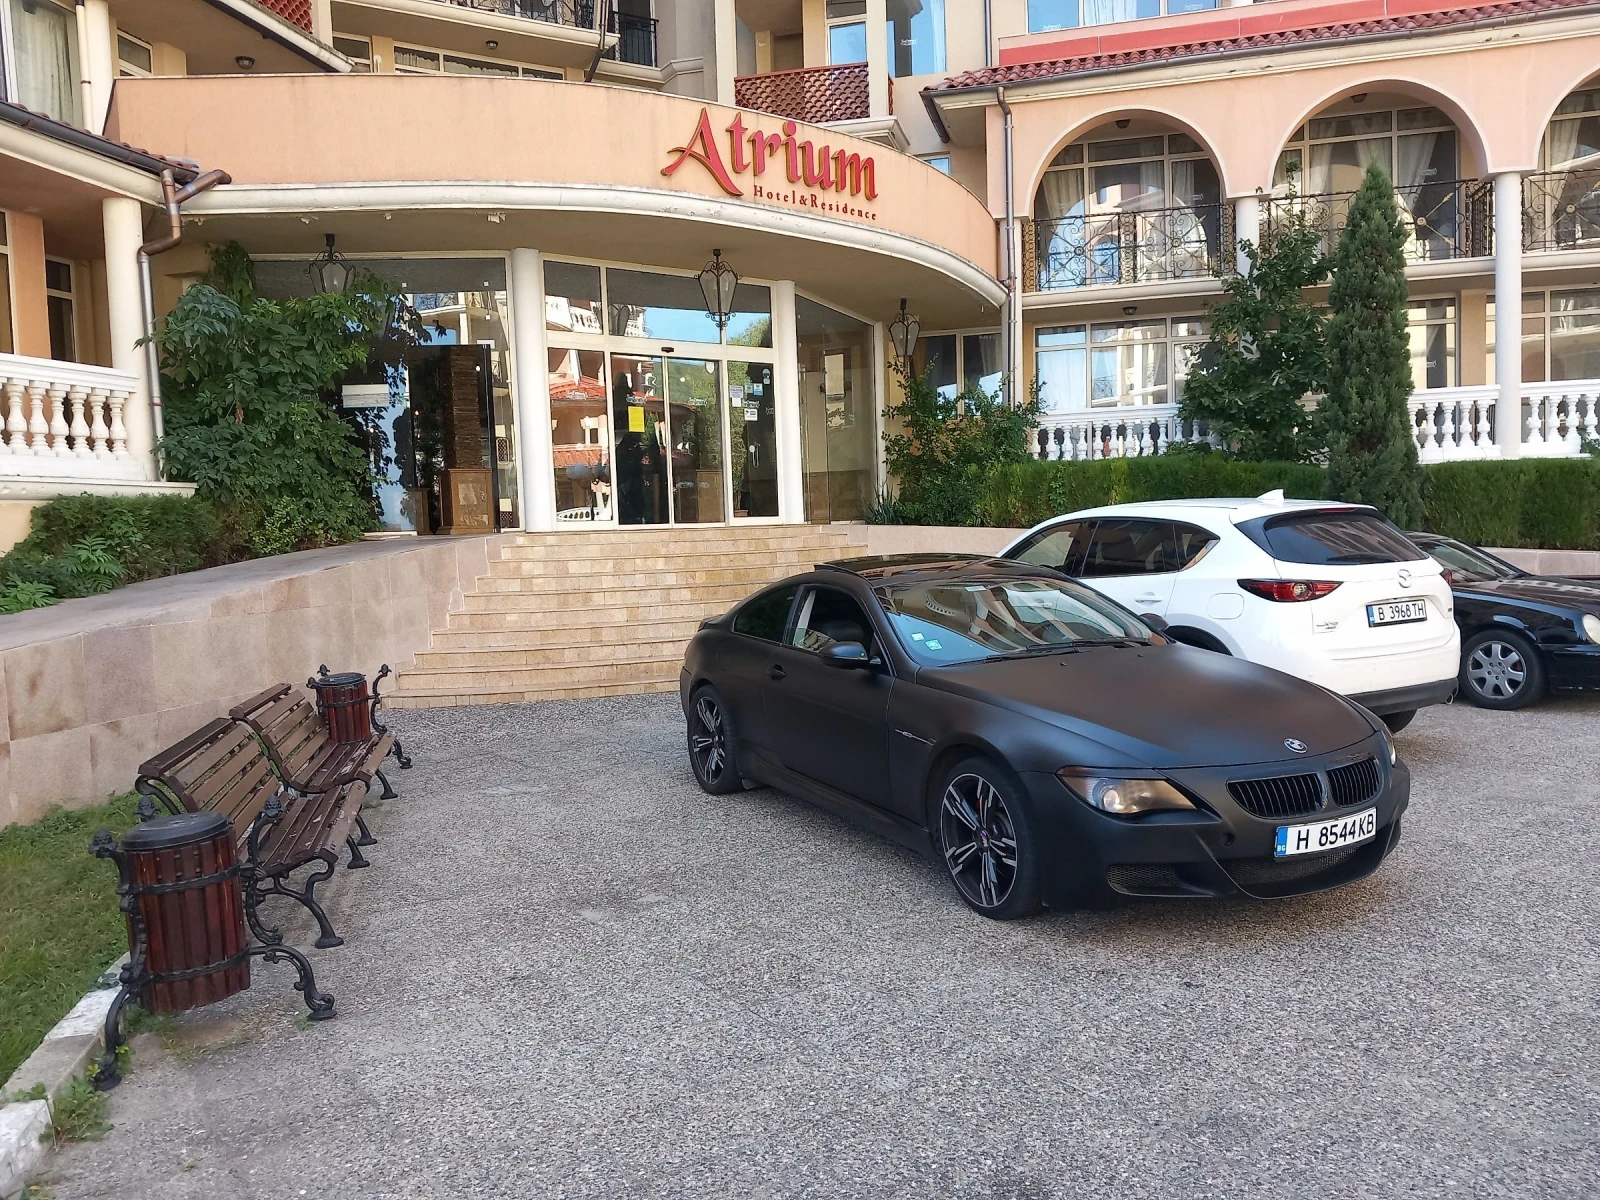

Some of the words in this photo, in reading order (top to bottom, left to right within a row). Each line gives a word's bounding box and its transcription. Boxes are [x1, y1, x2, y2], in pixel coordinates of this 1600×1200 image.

[660, 107, 879, 201] Atrium
[1378, 607, 1385, 620] B
[1296, 829, 1310, 850] H
